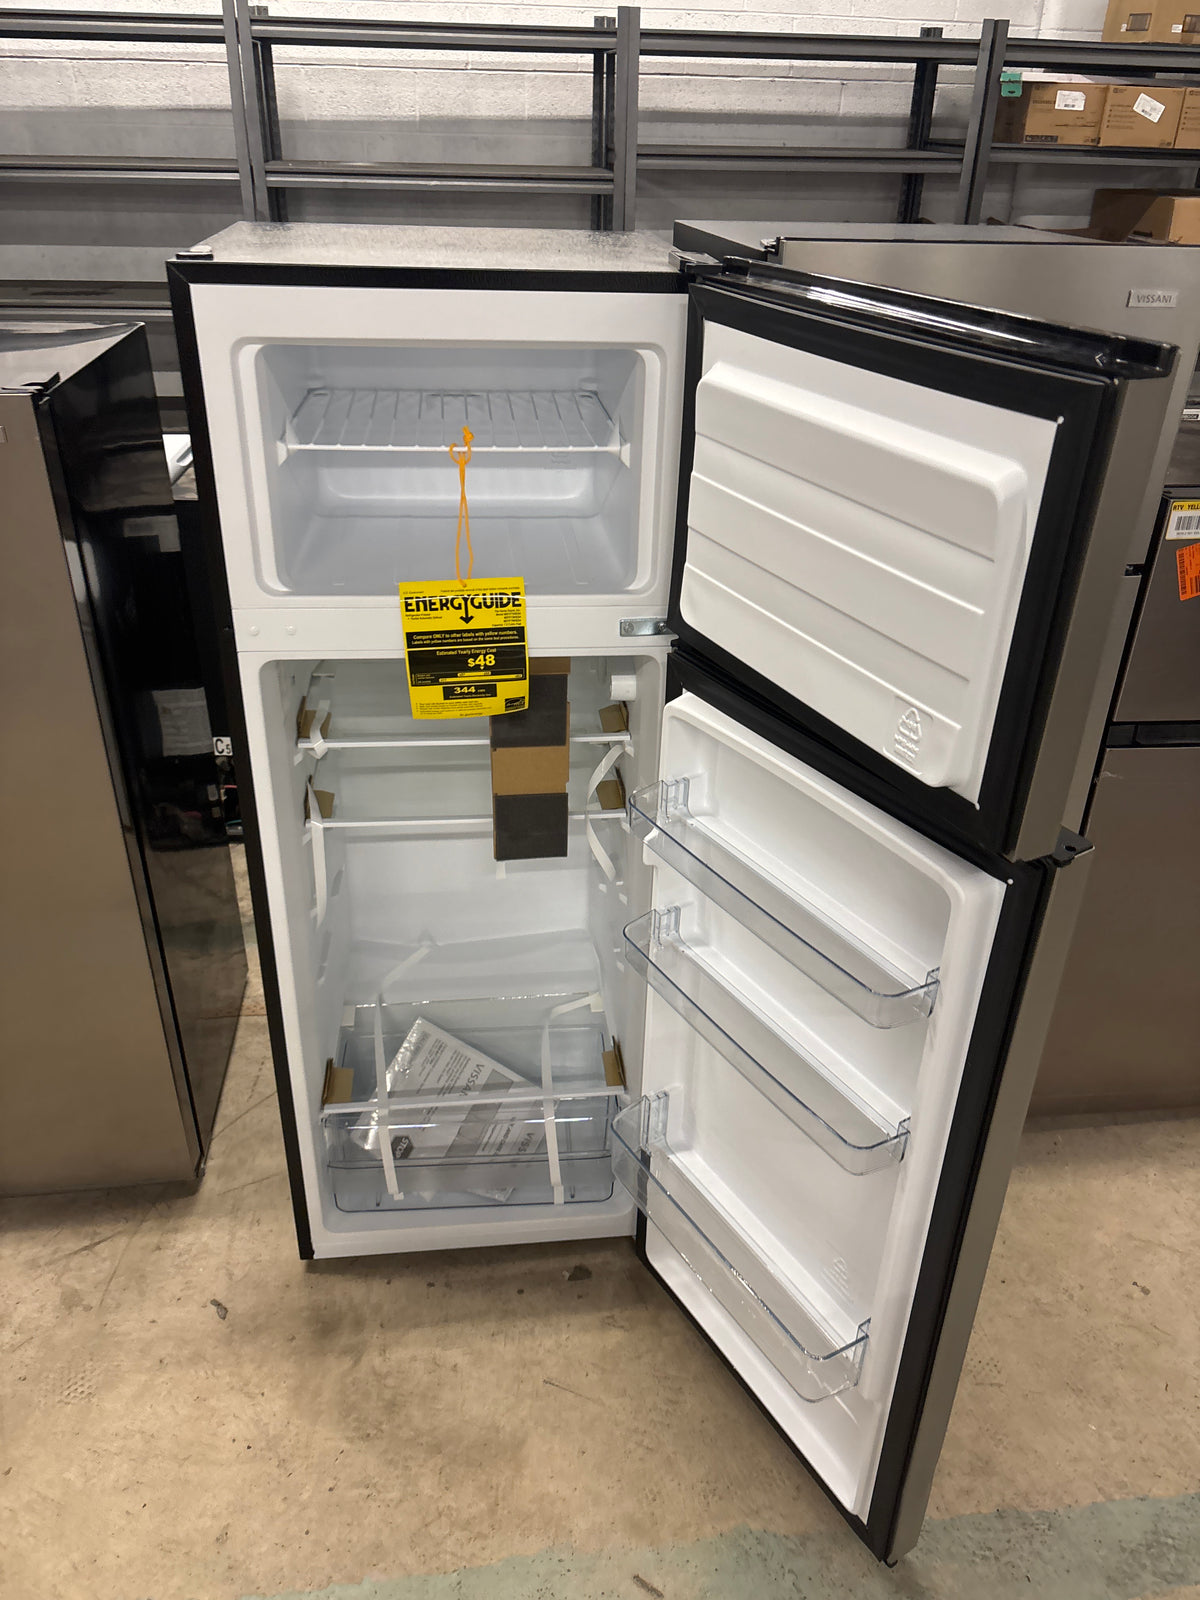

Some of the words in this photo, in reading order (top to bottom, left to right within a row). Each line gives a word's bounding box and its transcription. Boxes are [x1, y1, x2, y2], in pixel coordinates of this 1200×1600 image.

[1136, 295, 1172, 304] VISSANI
[471, 648, 486, 656] Energy
[467, 654, 496, 668] $48
[453, 686, 476, 694] 344
[459, 1063, 485, 1097] VISSA
